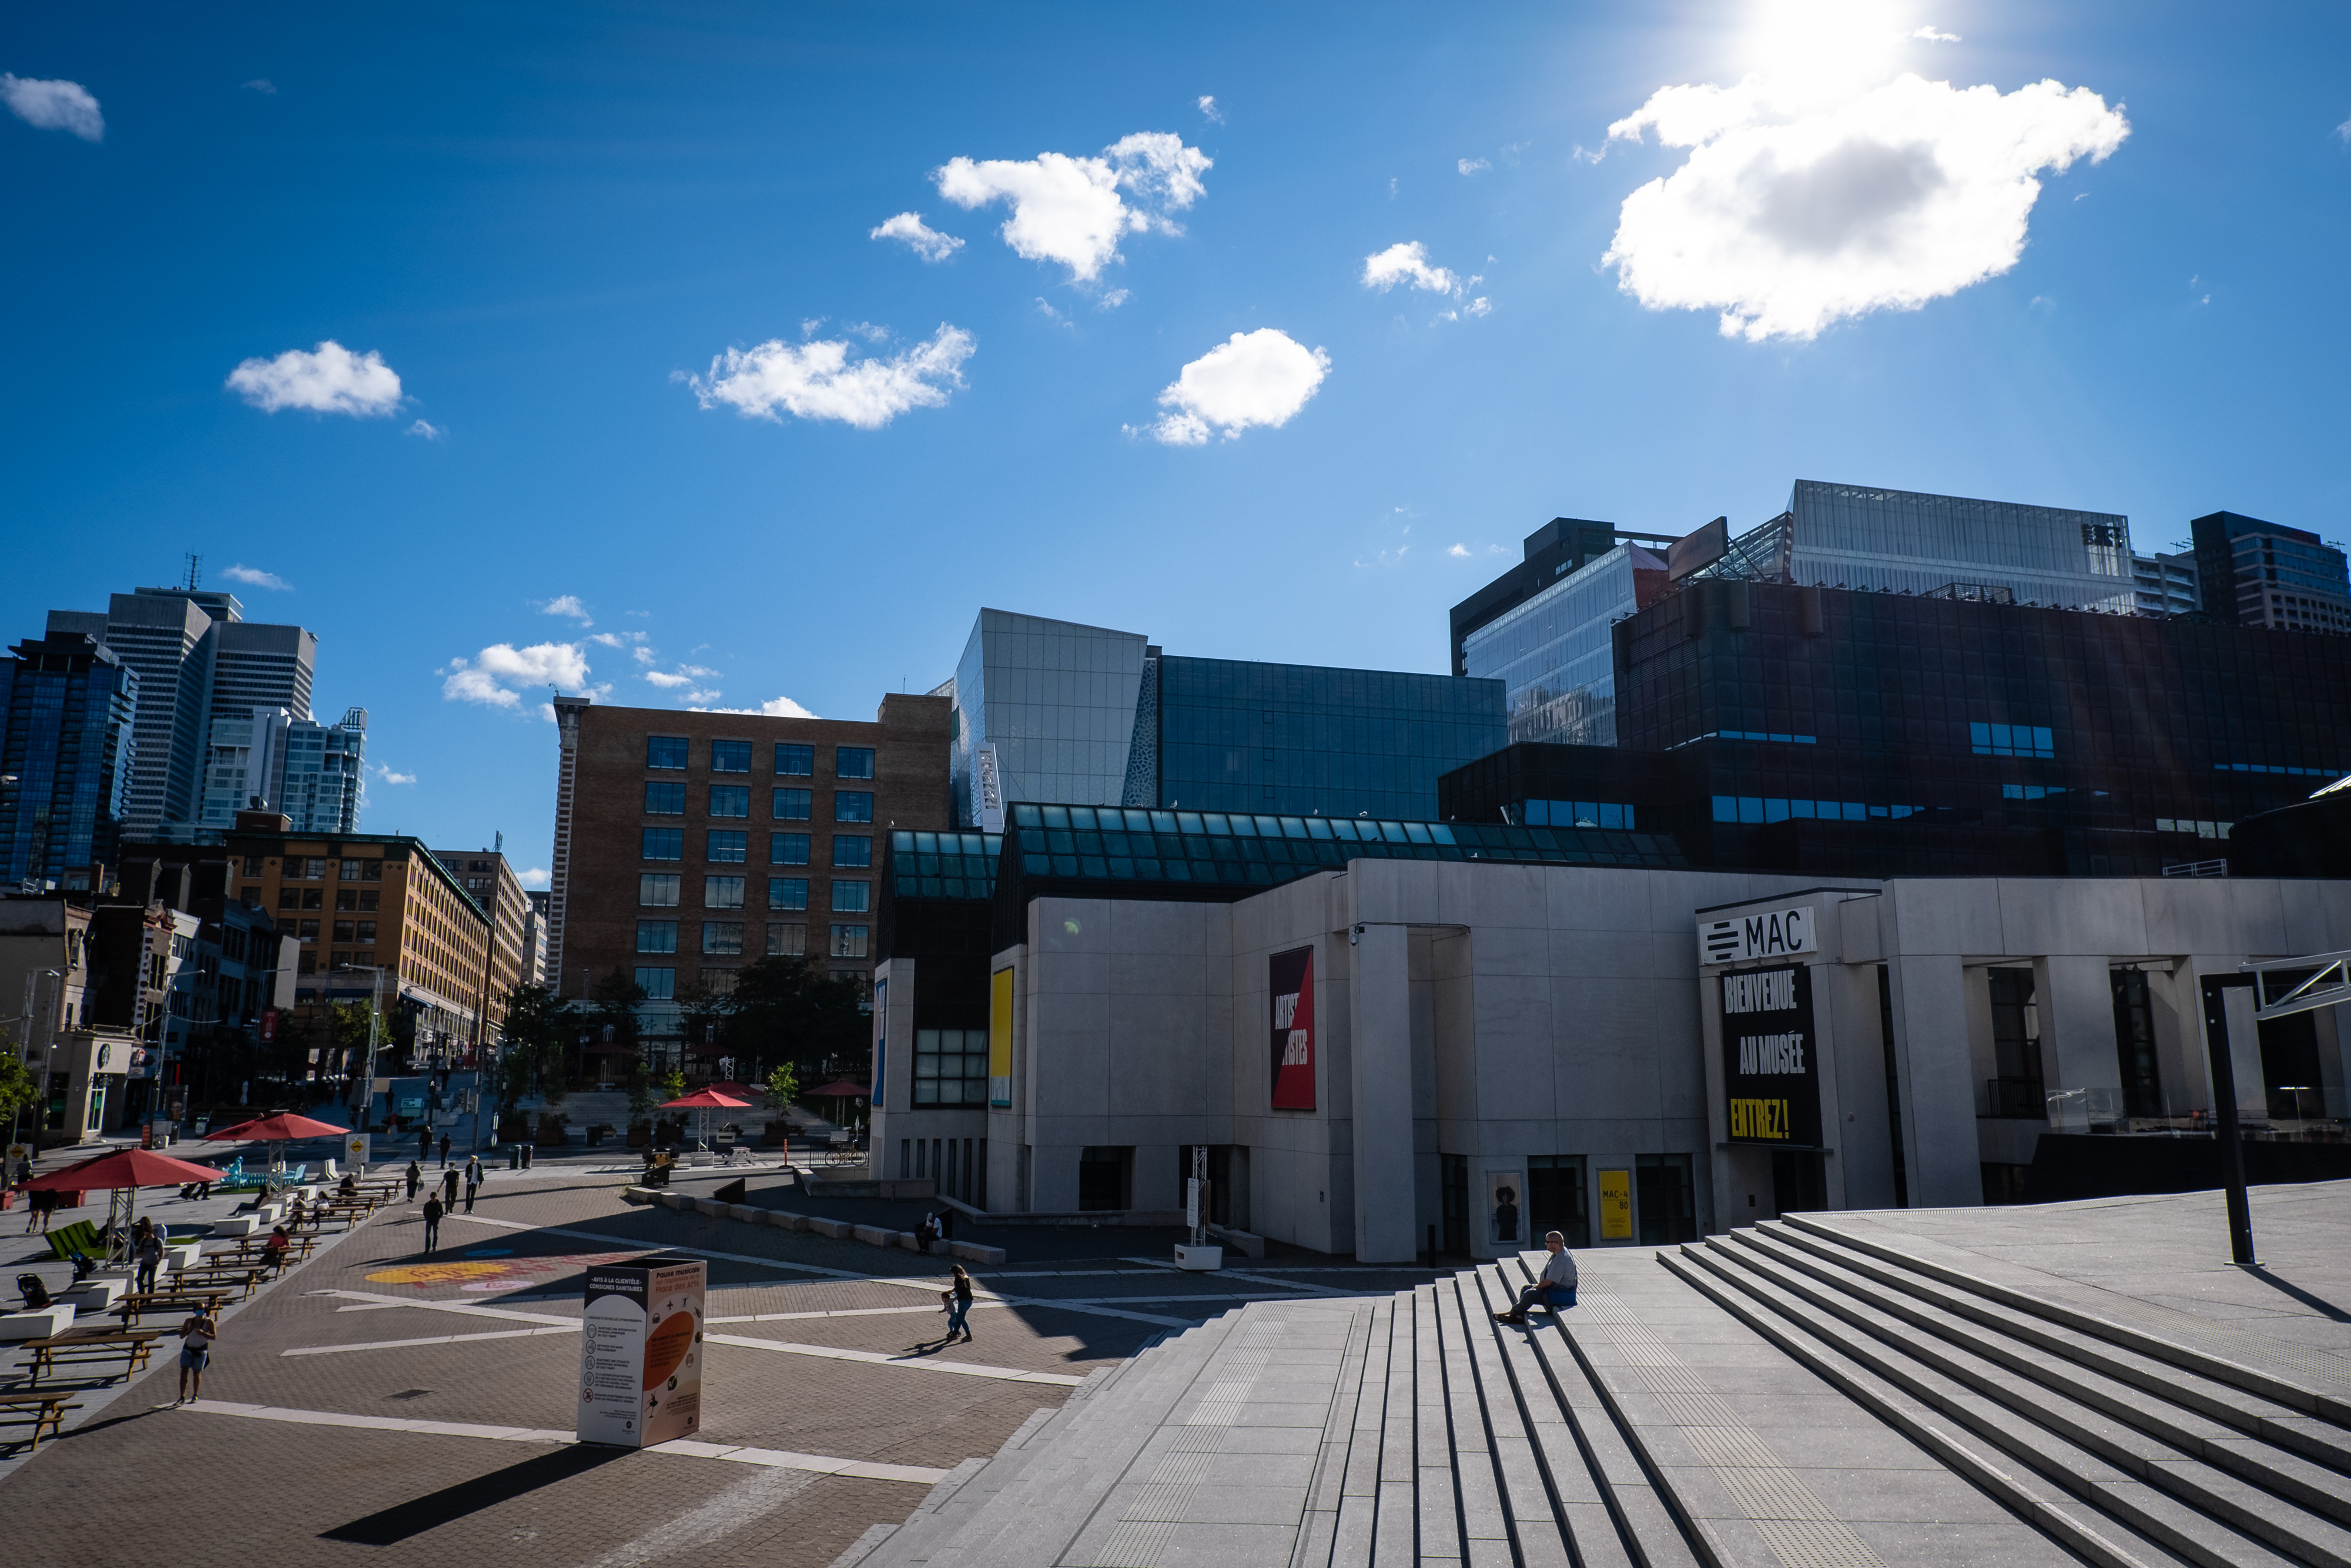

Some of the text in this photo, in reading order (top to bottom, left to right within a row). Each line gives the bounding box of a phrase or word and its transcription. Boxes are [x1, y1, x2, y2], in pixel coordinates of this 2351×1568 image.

[1745, 911, 1802, 956] MAC
[1724, 969, 1797, 1014] BIENVENUE
[1740, 1030, 1805, 1074] AU MUSÉE
[656, 1285, 672, 1293] Place
[687, 1280, 699, 1288] Arts
[676, 1266, 700, 1275] musicale
